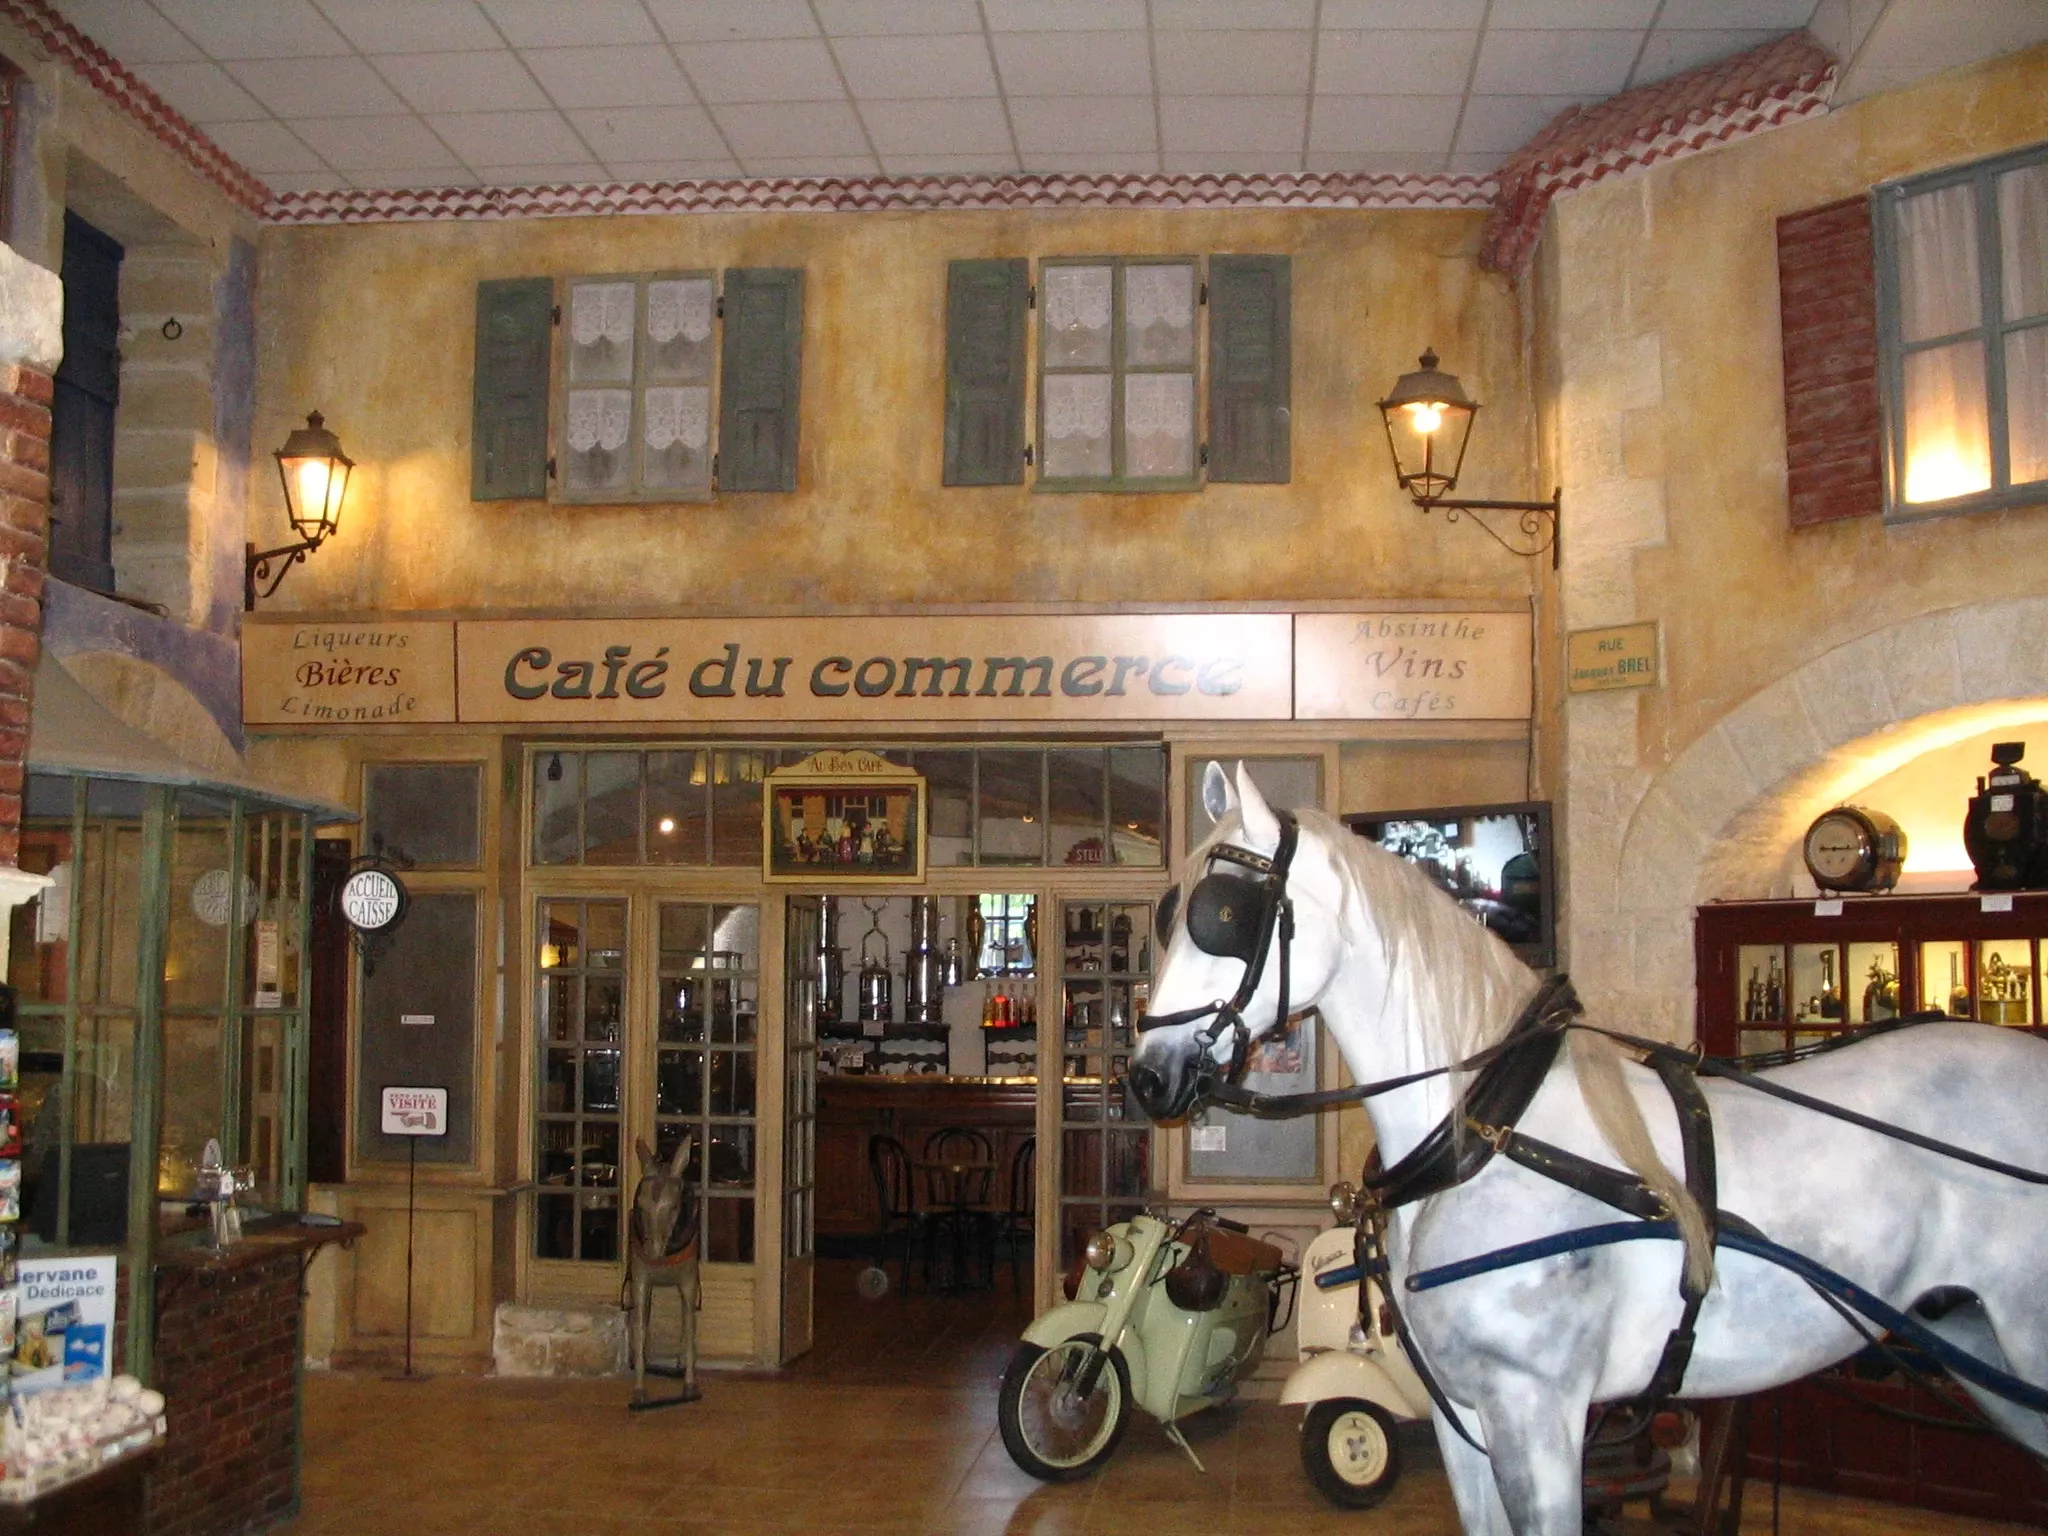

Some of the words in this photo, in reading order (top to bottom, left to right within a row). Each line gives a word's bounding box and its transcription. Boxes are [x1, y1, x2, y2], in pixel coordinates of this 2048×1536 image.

[293, 628, 409, 652] Liqueurs
[1350, 615, 1485, 644] Absinthe
[1598, 637, 1624, 652] RUE
[296, 657, 401, 688] Bières
[504, 646, 670, 699] Café
[689, 643, 793, 697] du
[809, 653, 1246, 698] commerce
[1365, 646, 1468, 680] Vins
[280, 693, 417, 721] Limonade
[348, 874, 396, 899] ACCUEIL
[349, 900, 393, 926] CAISSE
[389, 1099, 437, 1110] VISITE
[16, 1268, 98, 1283] ervane
